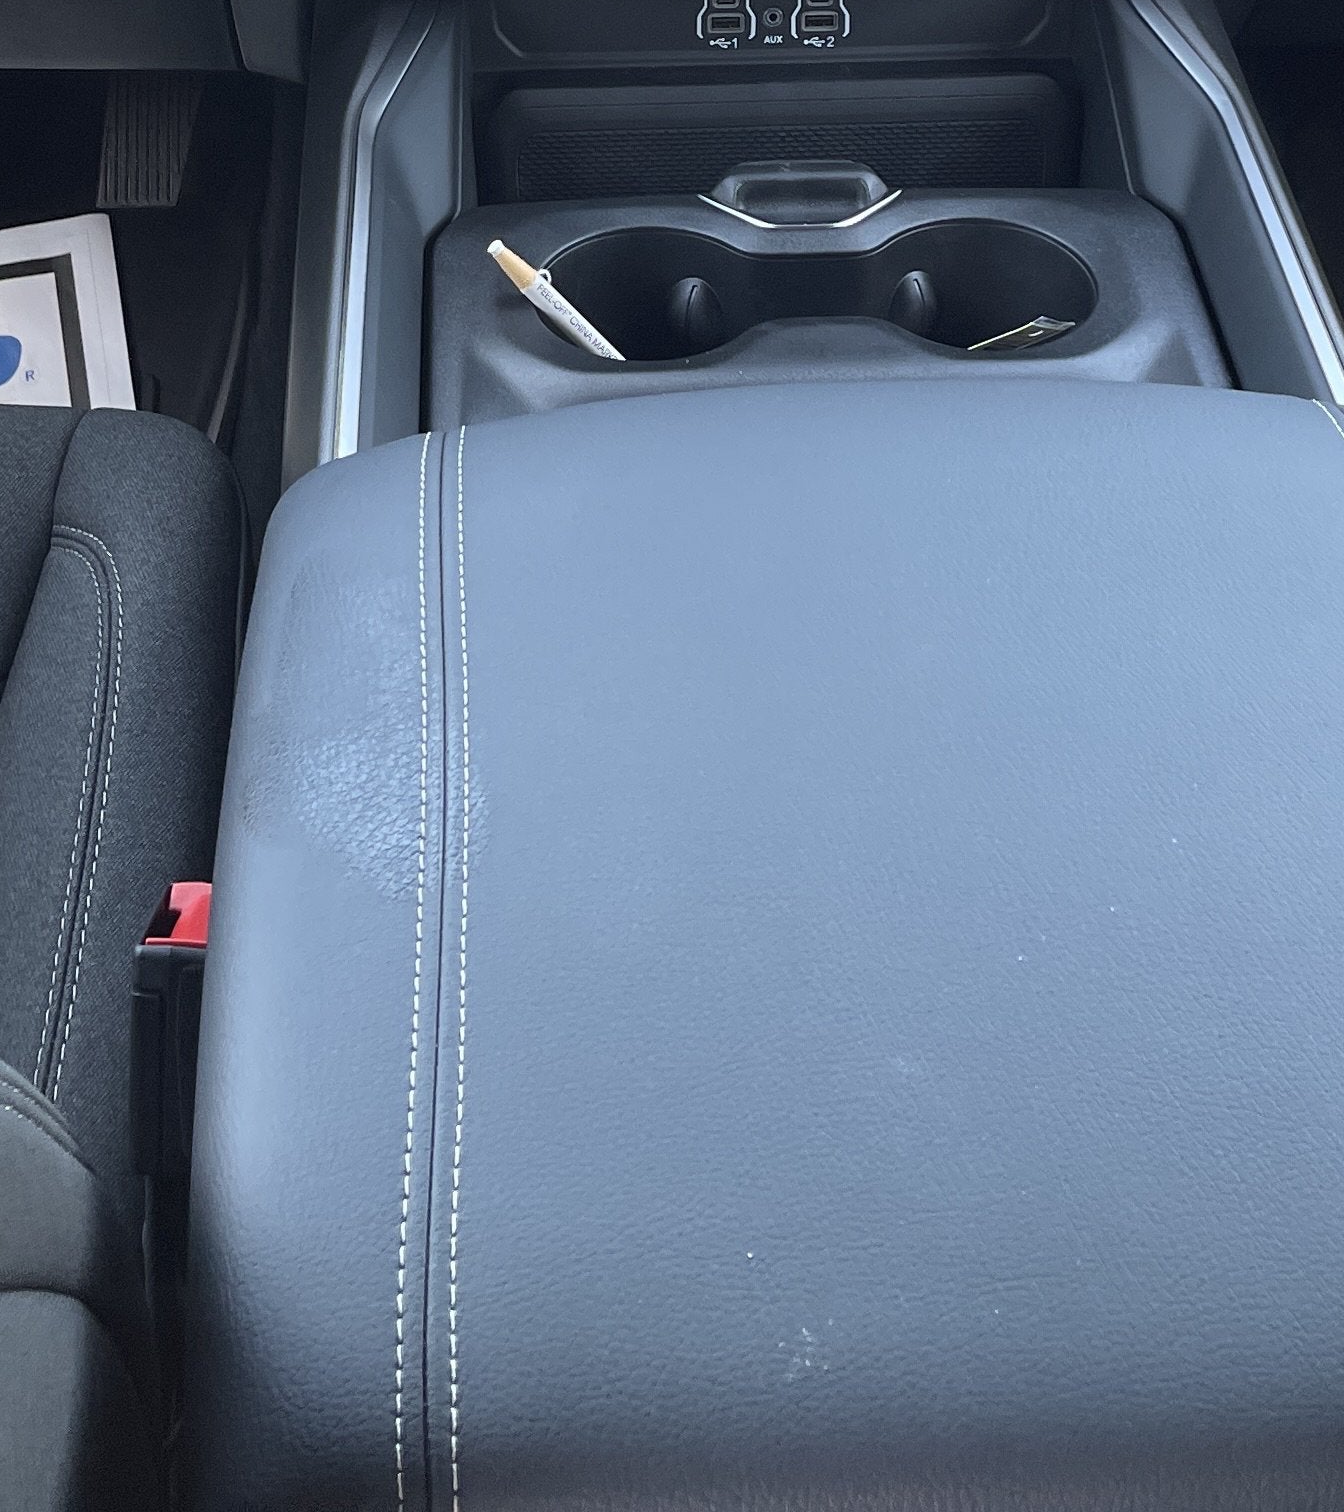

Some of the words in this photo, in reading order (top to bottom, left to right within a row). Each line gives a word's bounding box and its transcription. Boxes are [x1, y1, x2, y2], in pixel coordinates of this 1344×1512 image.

[763, 35, 784, 44] AUX
[826, 36, 835, 48] 2
[569, 316, 593, 341] CHINA
